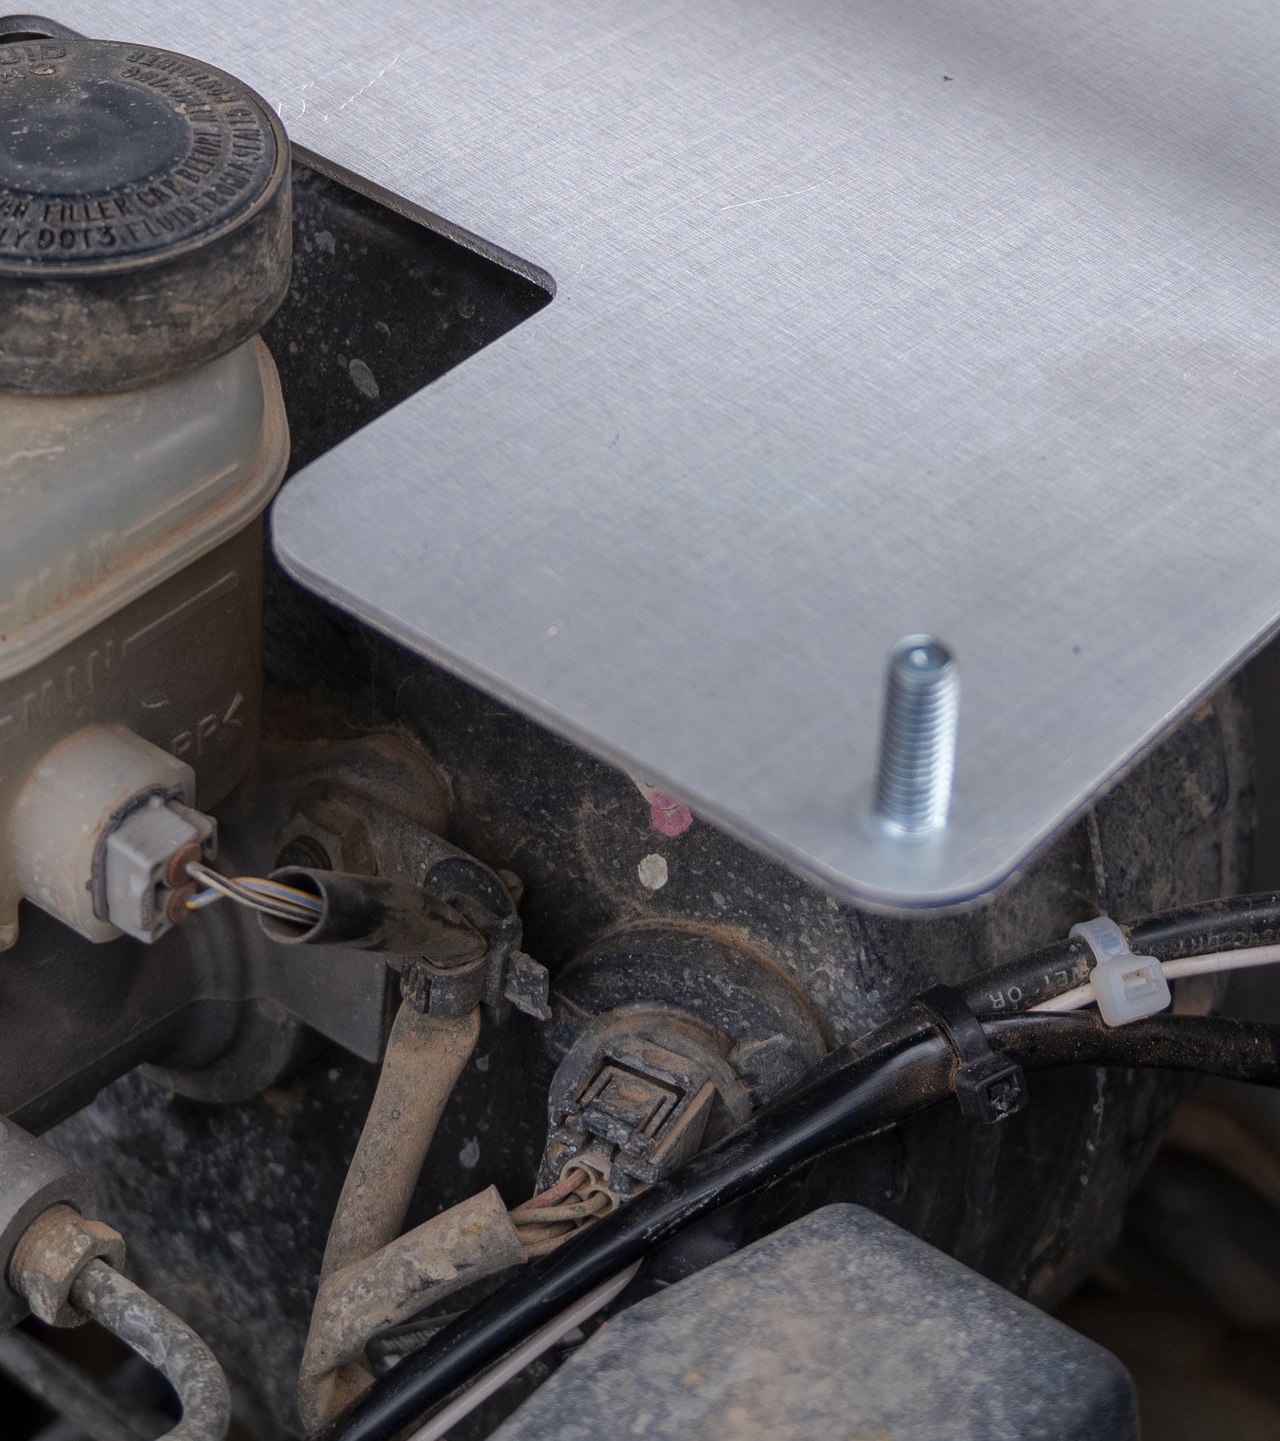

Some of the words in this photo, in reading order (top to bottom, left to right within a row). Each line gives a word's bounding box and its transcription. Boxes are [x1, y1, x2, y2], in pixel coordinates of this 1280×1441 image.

[42, 197, 131, 223] FILLER
[136, 178, 181, 209] CAP
[174, 131, 223, 184] BEFORE
[125, 205, 199, 243] FLUID
[190, 170, 251, 215] FROM
[989, 986, 1023, 1009] OR
